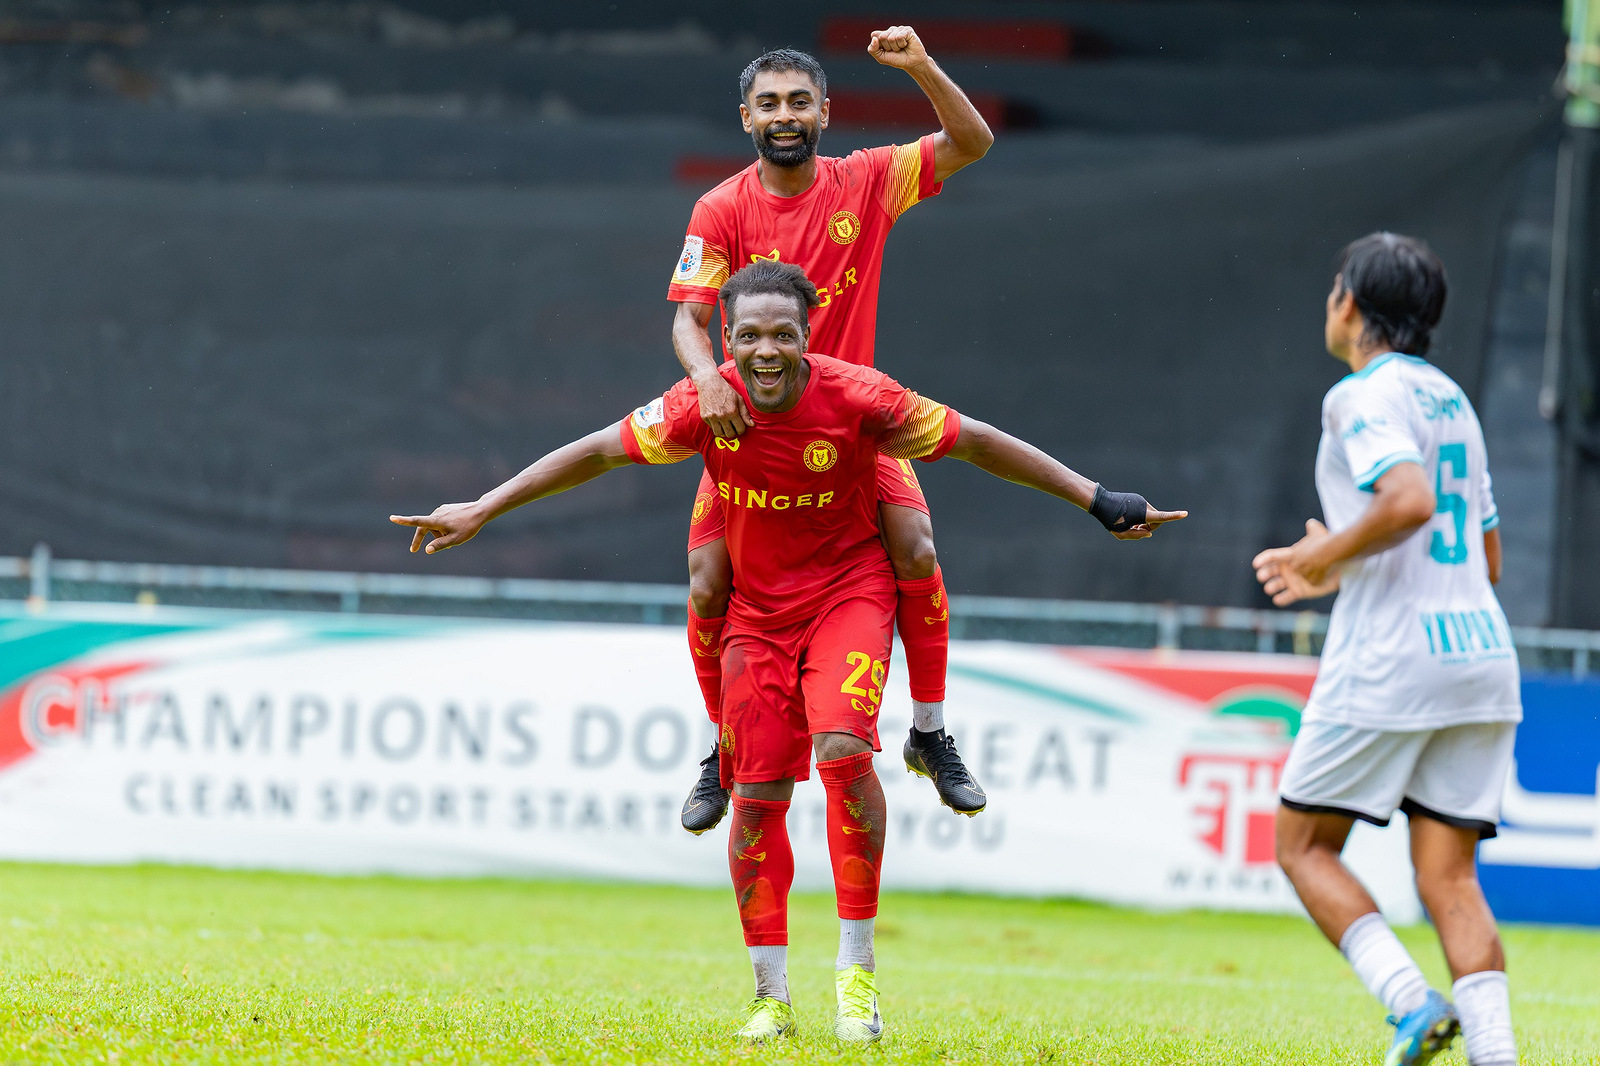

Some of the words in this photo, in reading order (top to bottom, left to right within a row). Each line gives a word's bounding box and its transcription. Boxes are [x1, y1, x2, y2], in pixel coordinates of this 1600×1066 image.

[718, 482, 834, 510] SINGER
[1430, 443, 1468, 564] 5
[840, 651, 885, 705] 29
[22, 674, 540, 767] CHAMPIONS
[123, 771, 298, 819] CLEAN
[317, 779, 495, 827] SPORT
[896, 806, 1006, 851] YOU
